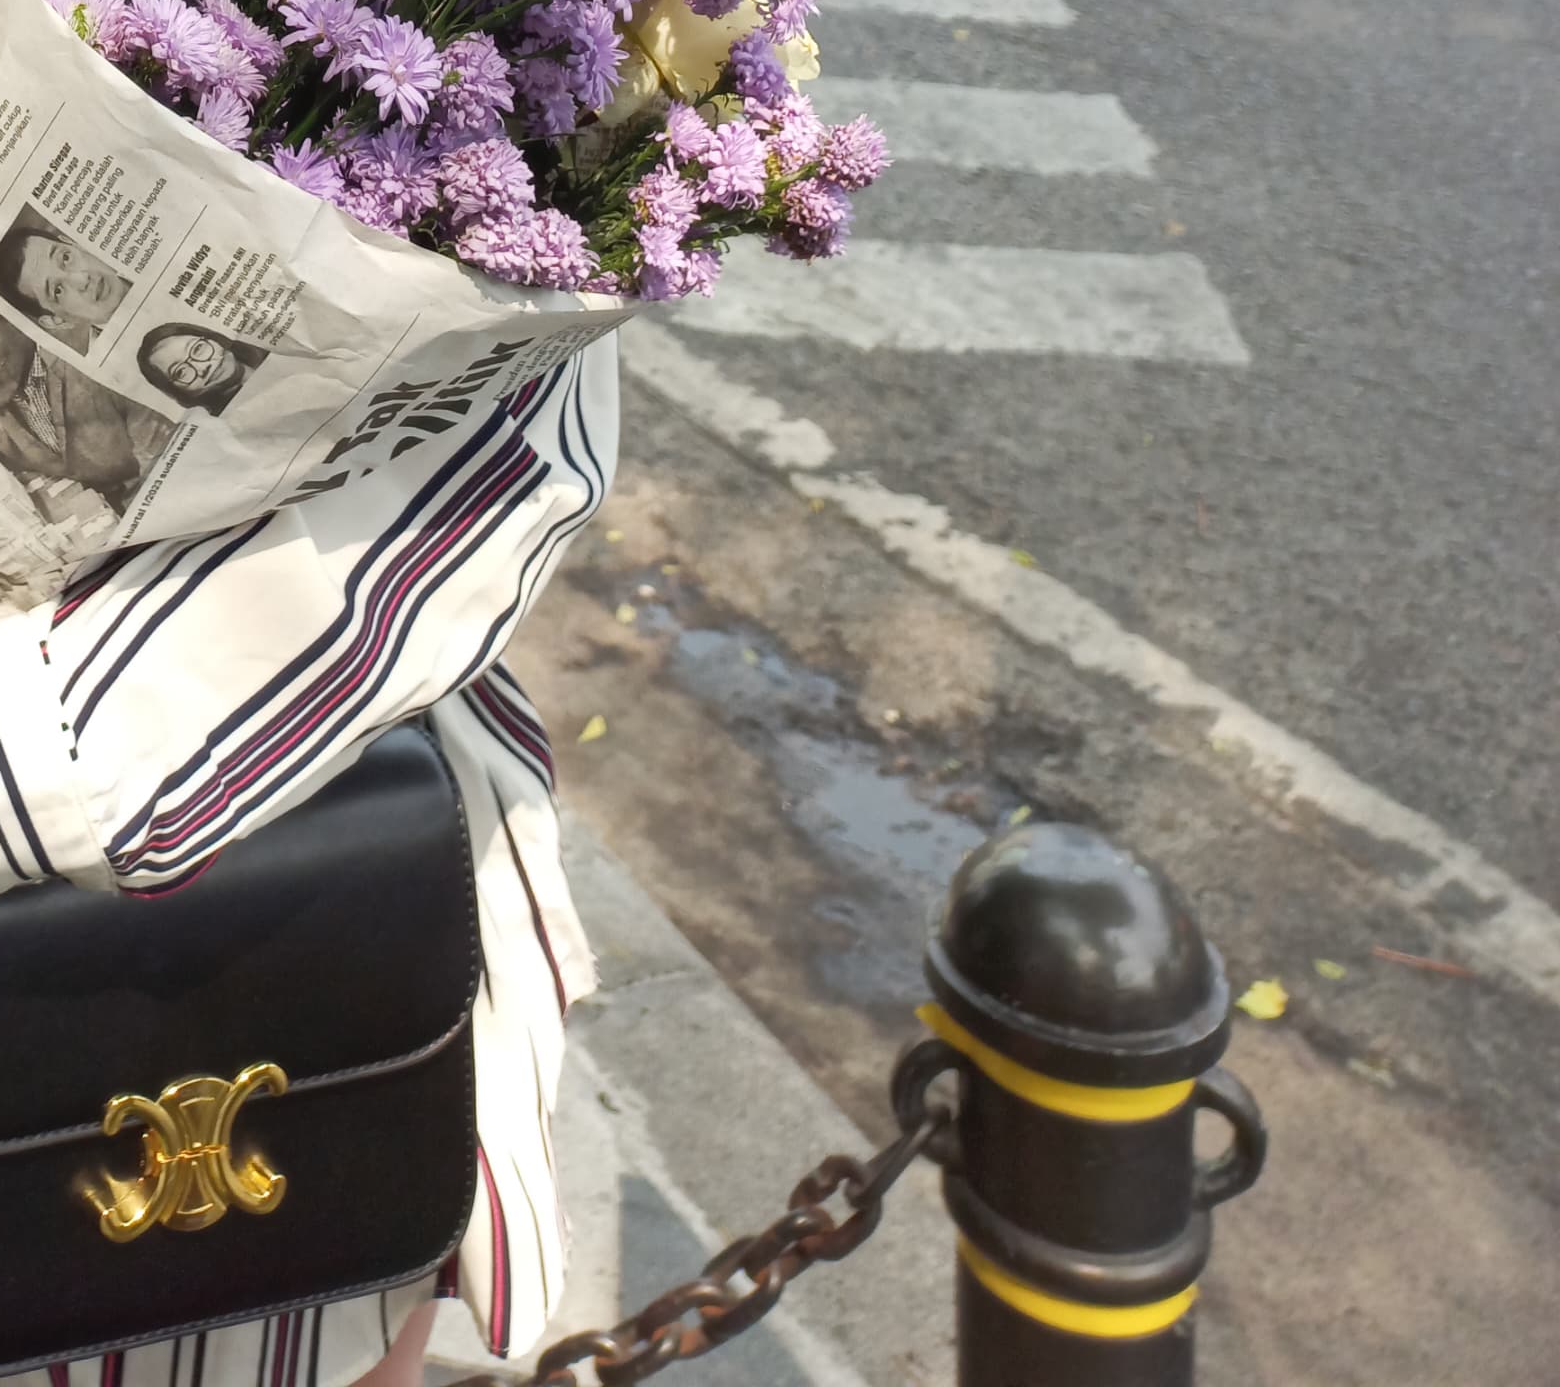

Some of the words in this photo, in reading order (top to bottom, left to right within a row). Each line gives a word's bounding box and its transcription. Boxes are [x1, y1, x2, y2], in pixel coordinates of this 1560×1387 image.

[3, 105, 21, 130] cukup
[31, 170, 53, 199] Kharim
[49, 142, 71, 171] Siregar
[53, 173, 68, 190] Bank
[64, 183, 94, 225] kolaborasi
[92, 154, 113, 183] adalah
[70, 159, 94, 193] percaya
[76, 214, 92, 233] cara
[88, 193, 107, 216] yang
[102, 167, 124, 194] paling
[88, 215, 106, 242] efektif
[104, 192, 123, 216] untuk
[99, 199, 135, 250] memberikan
[111, 208, 146, 259] pembiayaan
[141, 177, 167, 208] kepada
[121, 245, 139, 265] lebih
[134, 215, 159, 245] banyak
[169, 271, 193, 297] Novita
[186, 244, 210, 270] Widya
[184, 266, 216, 307] Anggraini
[198, 286, 219, 313] Direktur
[215, 261, 237, 287] Finance
[223, 253, 260, 300] melanjutkan
[243, 253, 276, 298] penyaluran
[322, 379, 443, 464] Tak
[124, 508, 146, 538] kuartal
[160, 452, 180, 478] sudah
[177, 424, 198, 451] sesuai
